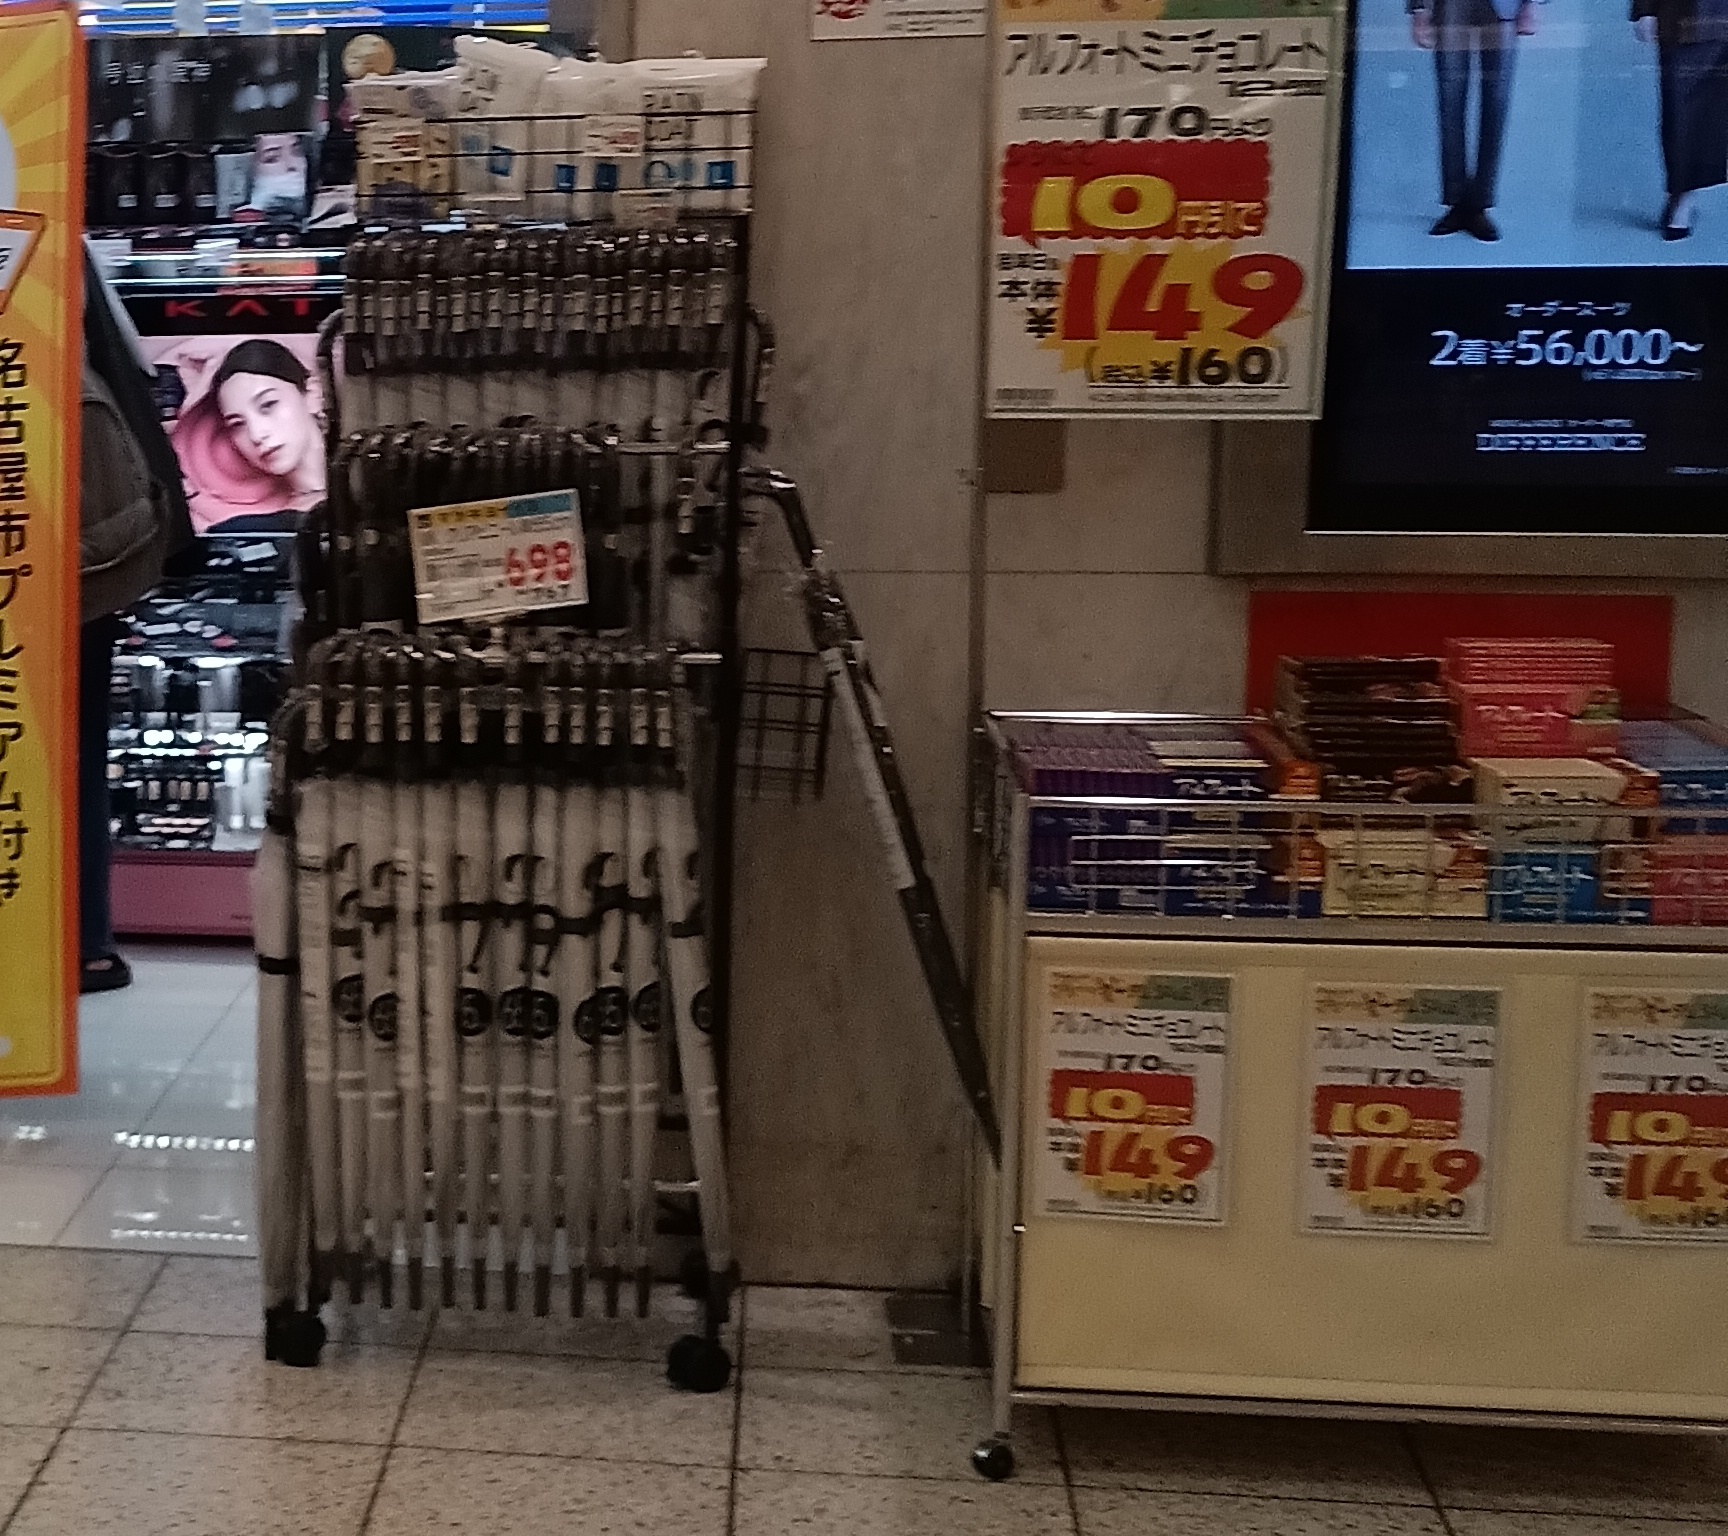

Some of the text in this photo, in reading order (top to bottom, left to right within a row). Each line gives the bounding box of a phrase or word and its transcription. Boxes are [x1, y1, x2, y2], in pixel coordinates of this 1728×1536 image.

[1061, 252, 1305, 341] 149
[1084, 1129, 1215, 1181] 149
[1348, 1144, 1484, 1195] 149
